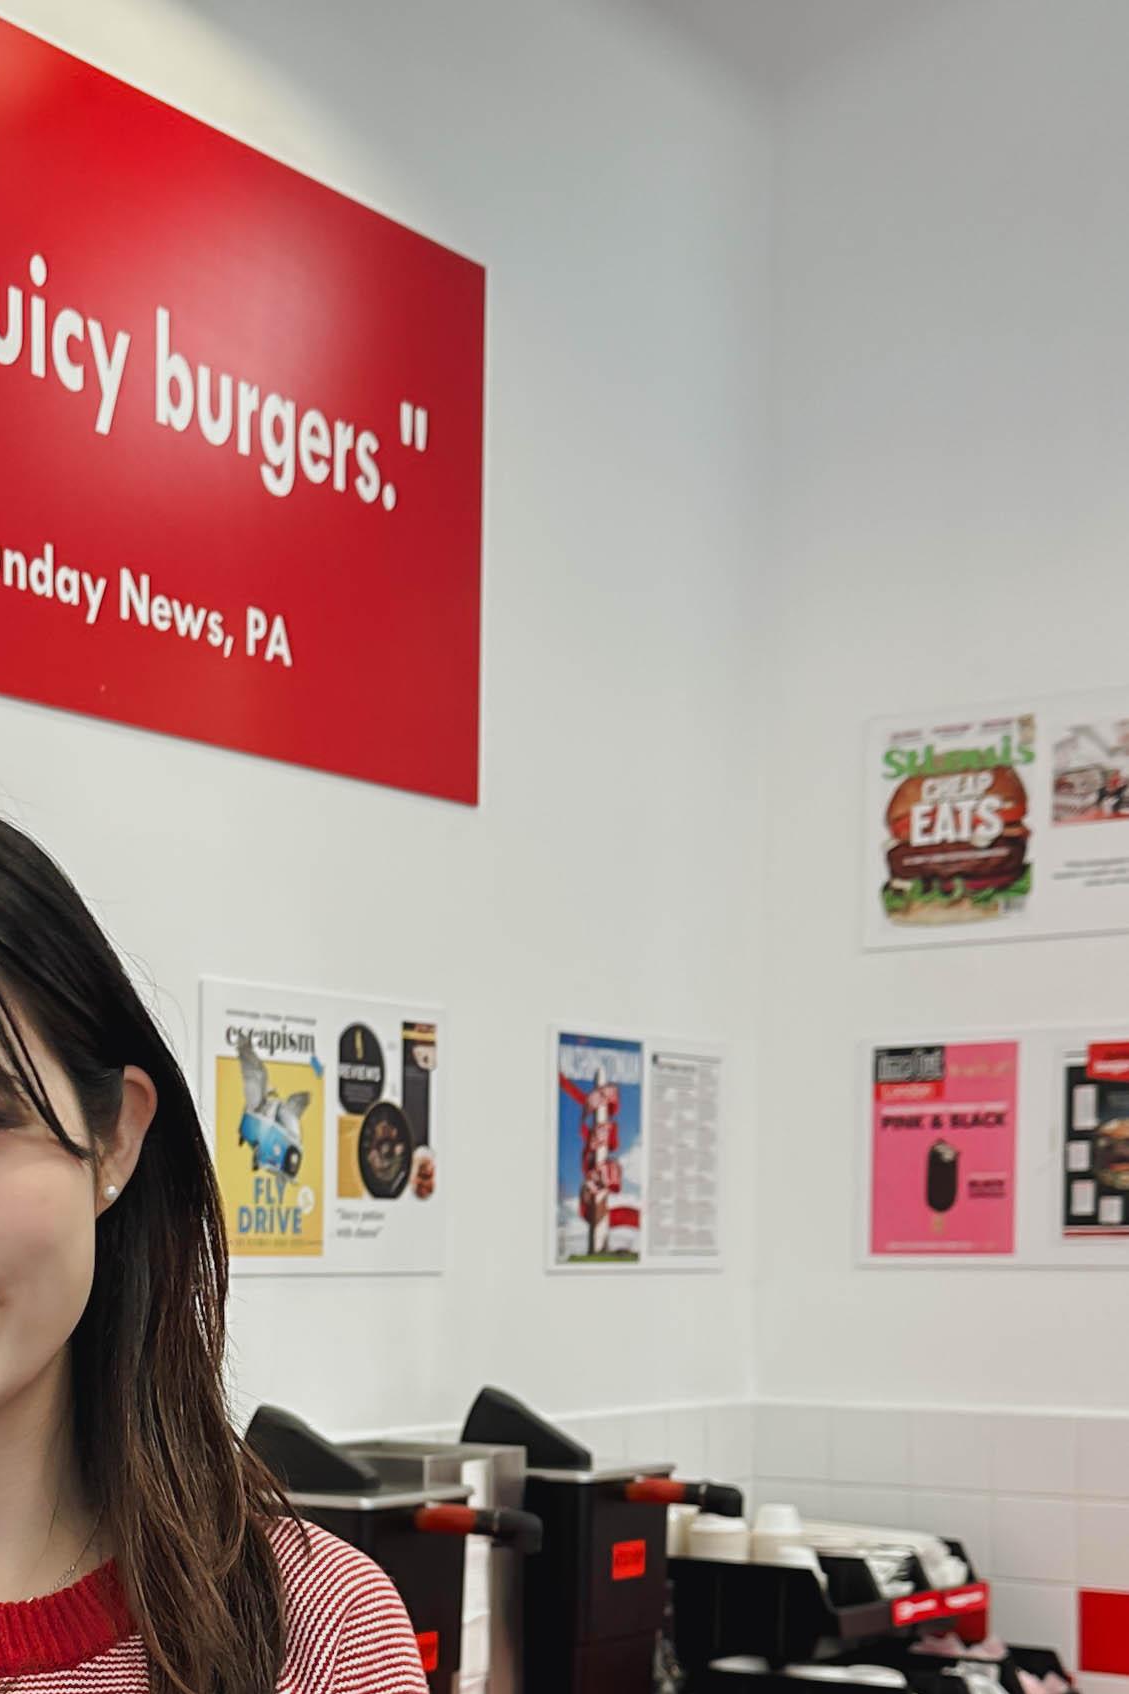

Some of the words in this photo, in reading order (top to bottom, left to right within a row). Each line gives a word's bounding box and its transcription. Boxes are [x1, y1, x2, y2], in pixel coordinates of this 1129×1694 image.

[155, 304, 428, 511] burgers."
[120, 567, 234, 659] News,
[246, 605, 293, 668] PA
[910, 796, 1003, 848] EATS
[238, 1206, 303, 1234] DRIVE
